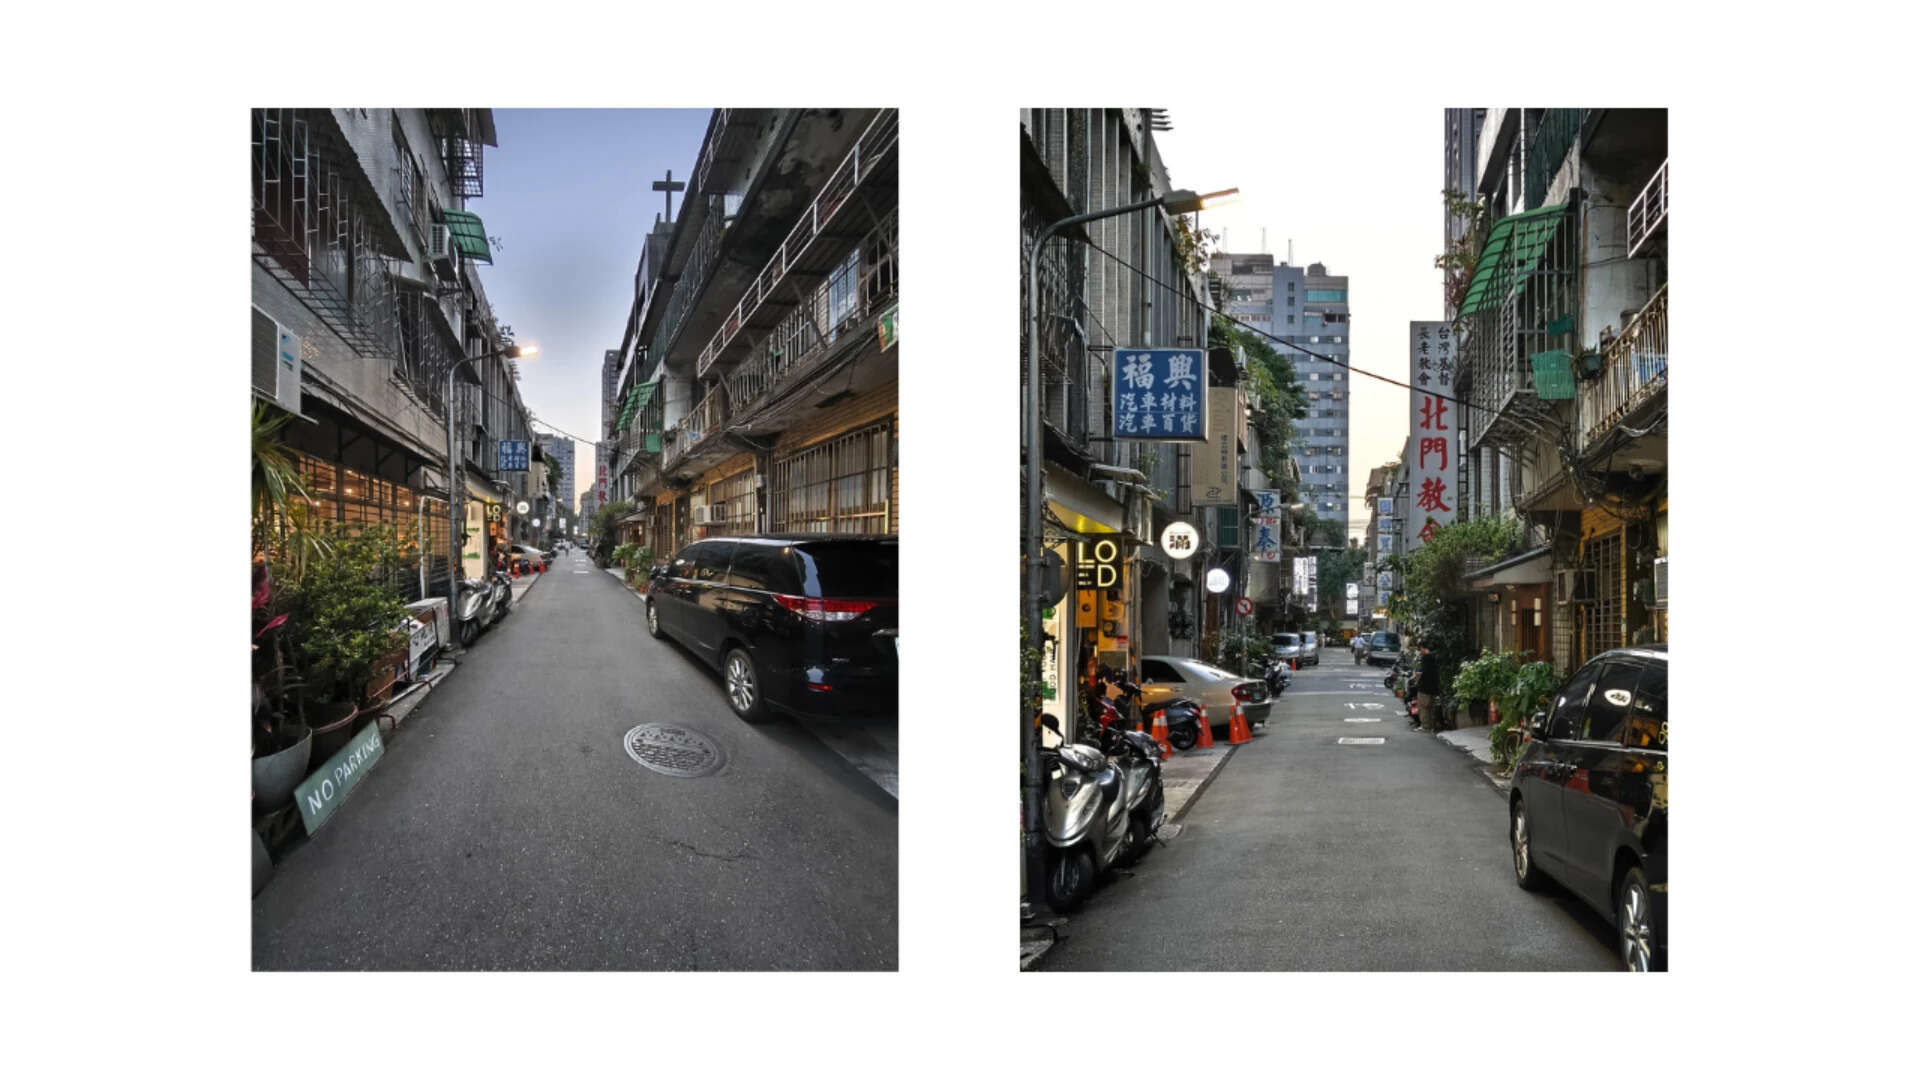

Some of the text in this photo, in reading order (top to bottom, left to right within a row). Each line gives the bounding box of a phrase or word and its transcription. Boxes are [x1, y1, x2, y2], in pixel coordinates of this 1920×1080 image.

[1122, 353, 1197, 390] 福興
[1119, 391, 1196, 412] 汽車材料
[1118, 412, 1198, 435] 汽車百貨
[307, 734, 380, 815] NO PARKING
